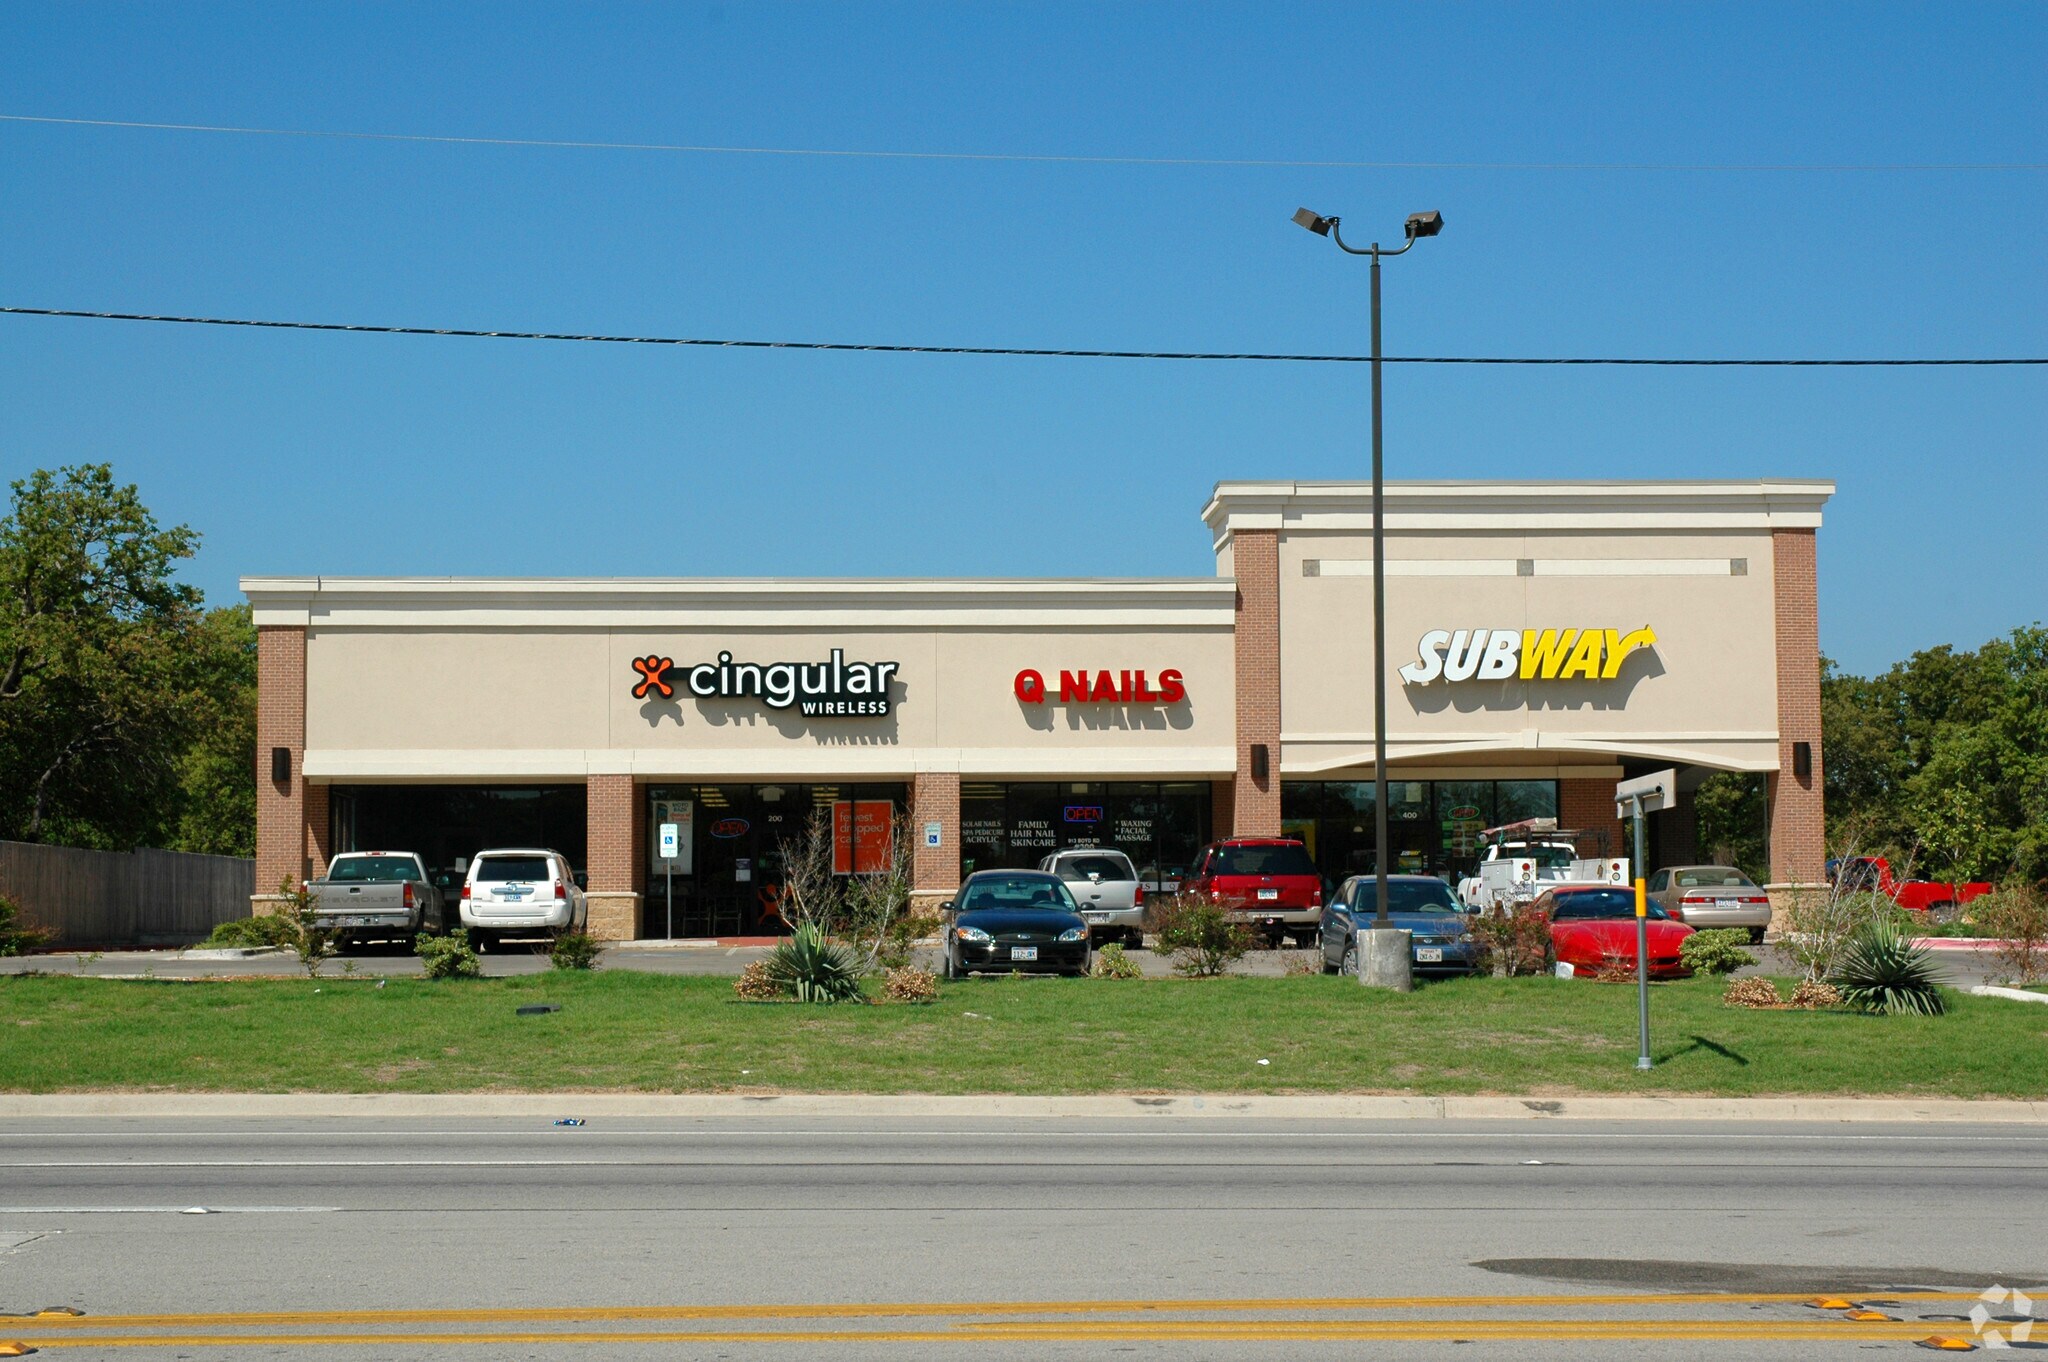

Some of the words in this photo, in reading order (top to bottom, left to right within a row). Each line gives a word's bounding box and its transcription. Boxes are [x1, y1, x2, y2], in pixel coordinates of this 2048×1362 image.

[1398, 624, 1657, 685] SUBWAY
[689, 648, 895, 708] cingular
[1014, 668, 1045, 704] Q
[1060, 668, 1185, 703] NAILS
[802, 701, 887, 715] WIRELESS
[1066, 807, 1102, 820] OPEN
[1018, 820, 1049, 829] FAMILY
[1120, 820, 1152, 828] WAXING
[840, 831, 862, 843] cals
[1010, 829, 1032, 838] HAIR
[1035, 829, 1056, 838] NAIL
[1120, 827, 1148, 835] FACIAL
